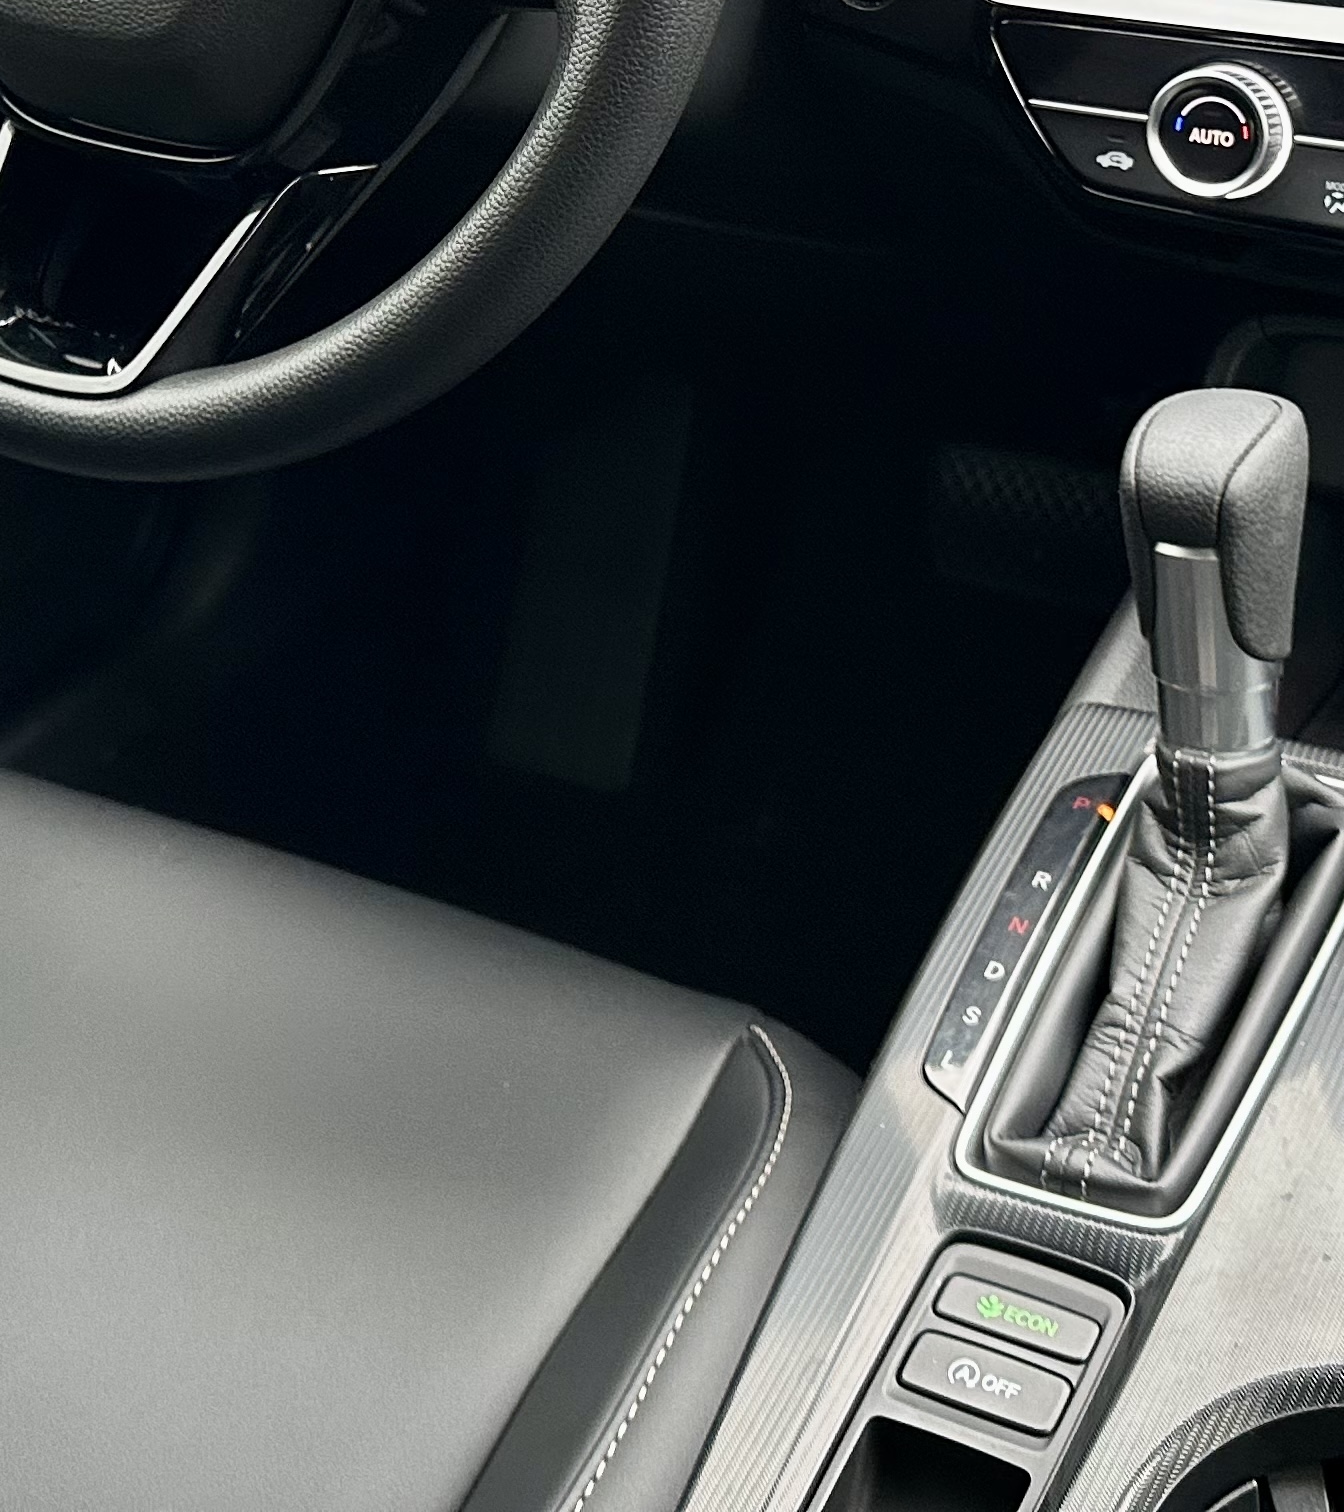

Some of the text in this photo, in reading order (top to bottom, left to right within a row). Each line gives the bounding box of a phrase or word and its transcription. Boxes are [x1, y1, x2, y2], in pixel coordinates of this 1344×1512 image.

[1189, 127, 1235, 148] AUTO
[1073, 796, 1091, 810] P
[1031, 870, 1053, 892] R
[1008, 915, 1030, 935] N
[983, 960, 1005, 981] D
[962, 1005, 982, 1026] S
[941, 1050, 954, 1071] L
[1003, 1304, 1058, 1338] ECON
[981, 1373, 1022, 1399] OFF
